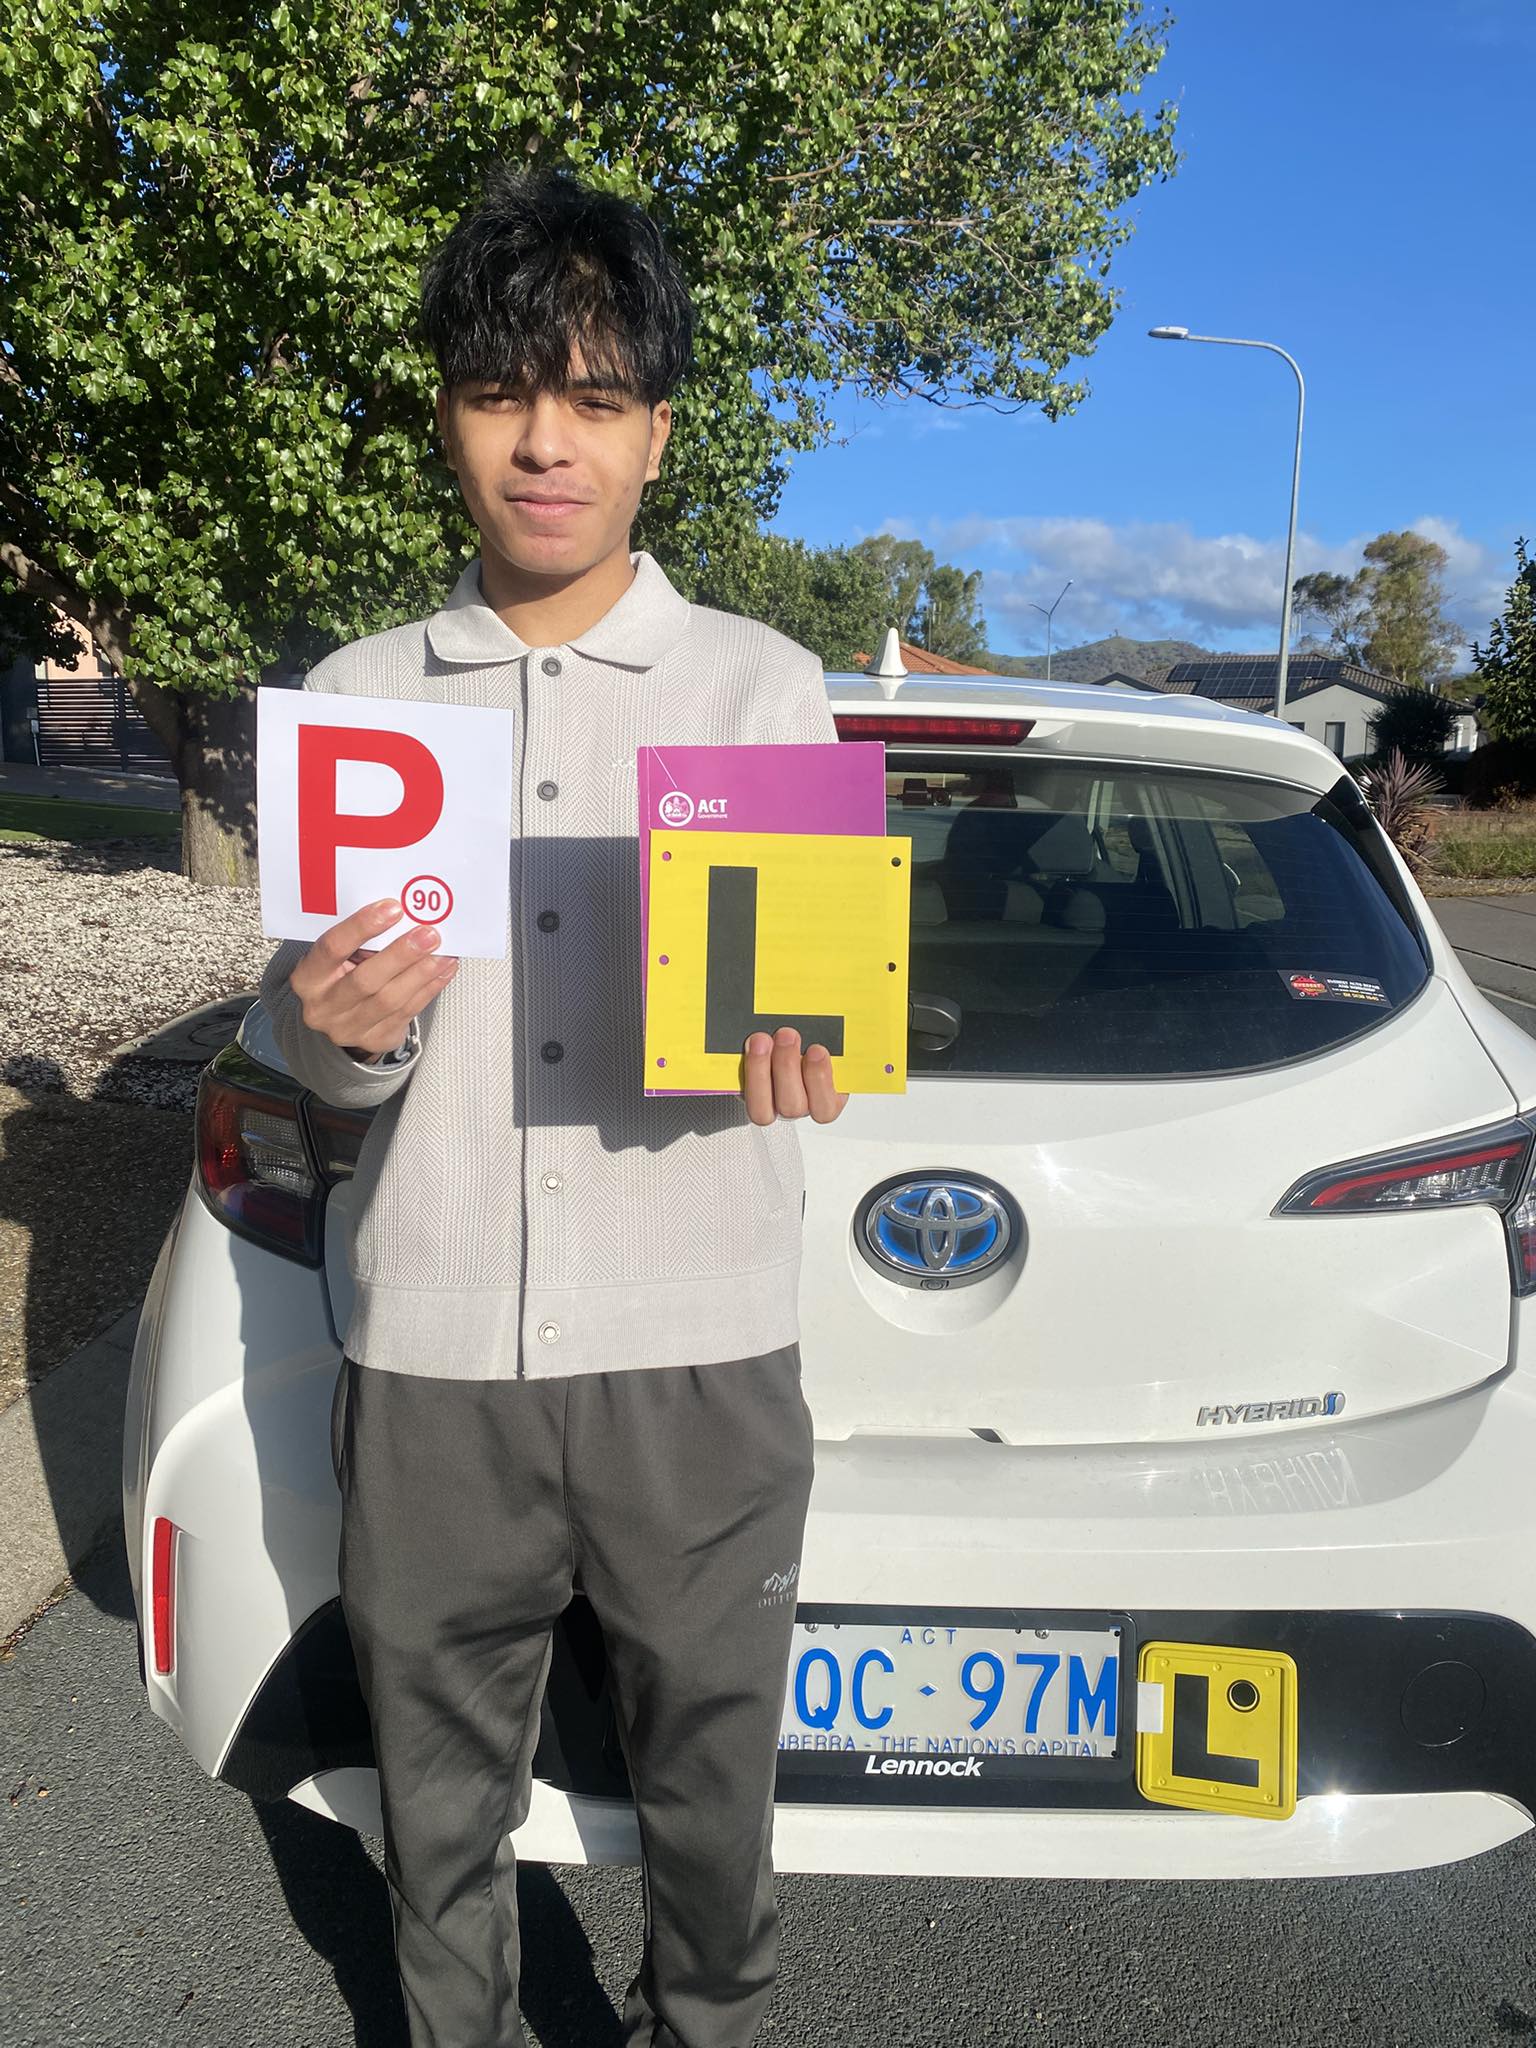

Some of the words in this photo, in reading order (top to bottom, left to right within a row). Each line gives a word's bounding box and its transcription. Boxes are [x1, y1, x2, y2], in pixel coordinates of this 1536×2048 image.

[698, 799, 728, 813] ACT
[298, 723, 444, 916] P
[412, 890, 441, 911] 90
[704, 865, 845, 1057] L
[1196, 1398, 1322, 1427] HYBRID
[901, 1628, 957, 1645] ACT
[795, 1648, 894, 1731] QC
[962, 1651, 1117, 1736] 97M
[1172, 1673, 1260, 1788] L
[880, 1736, 918, 1752] THE
[927, 1737, 1016, 1755] NATION'S
[1024, 1739, 1099, 1757] CAPITAL
[865, 1755, 984, 1777] Lennock
